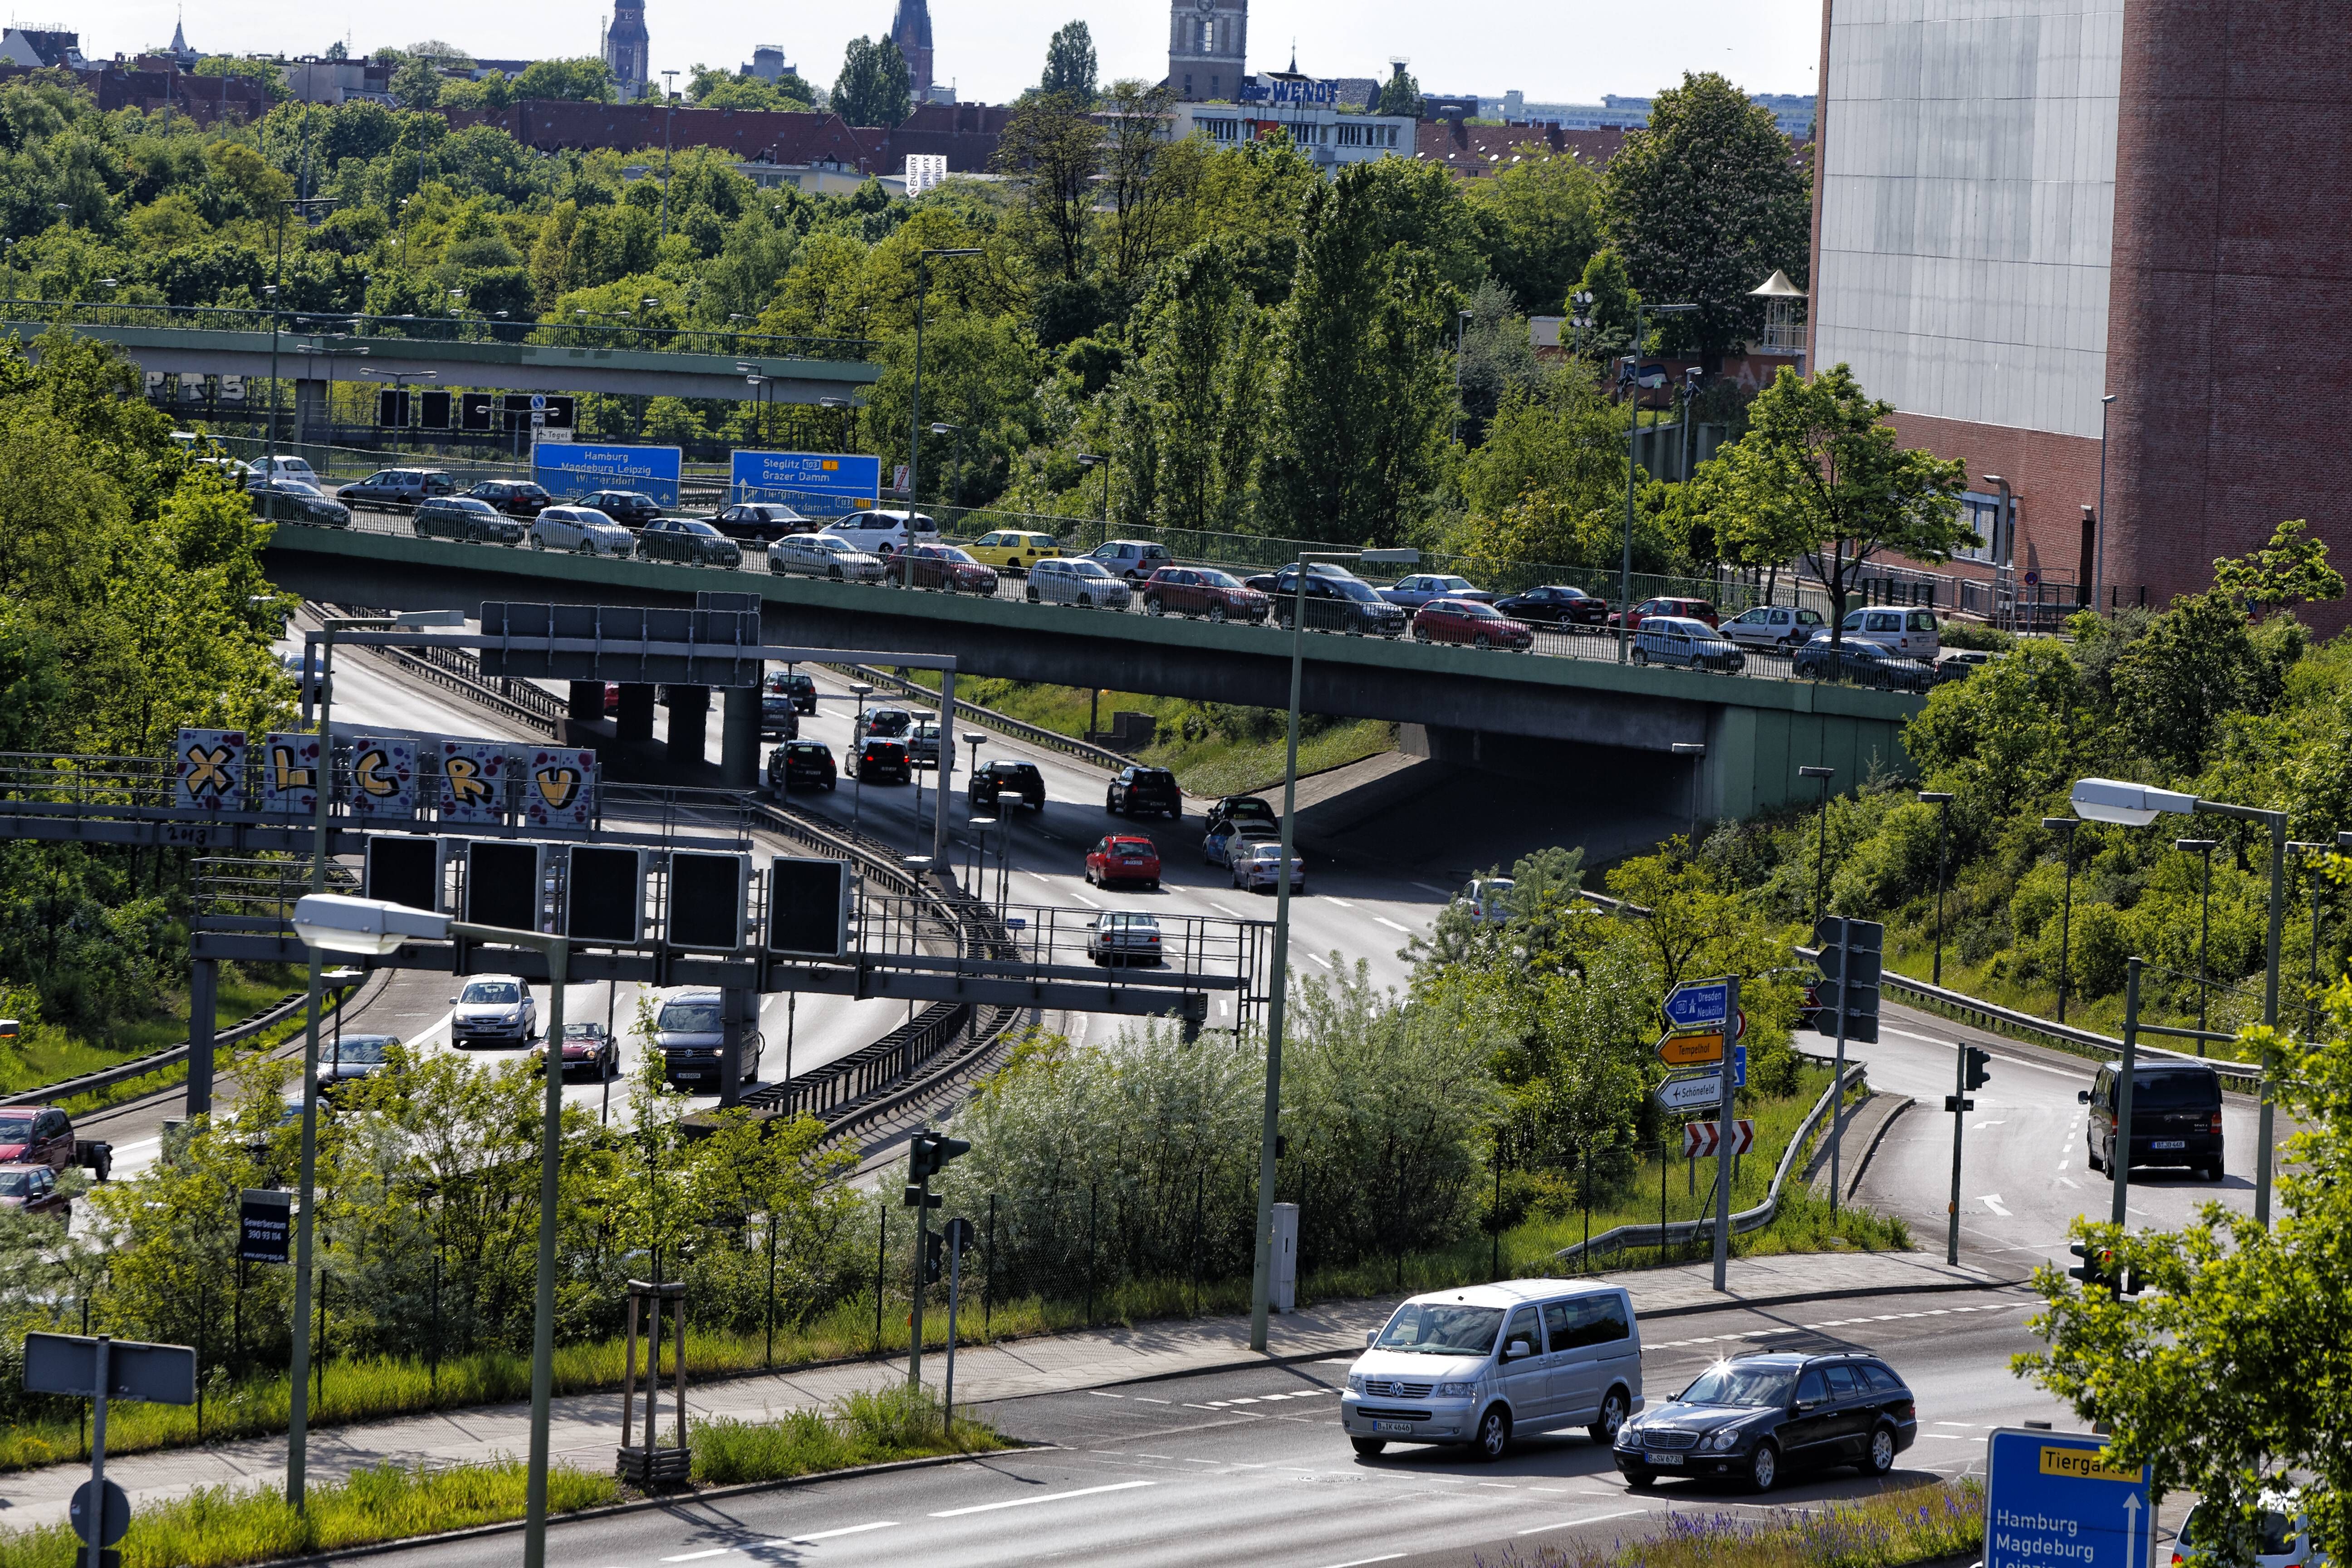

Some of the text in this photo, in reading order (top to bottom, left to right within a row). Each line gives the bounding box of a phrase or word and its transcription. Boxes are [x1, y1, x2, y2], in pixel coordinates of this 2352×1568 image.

[584, 451, 629, 463] Hamburg
[763, 458, 799, 469] Steglitz
[561, 462, 651, 476] Magdeburg Leipzig
[576, 473, 635, 486] Wiersdorf
[763, 470, 830, 482] Grazer Damm
[167, 826, 207, 845] 2013
[1698, 990, 1722, 1002] Dresden
[1677, 1003, 1686, 1011] 100
[1697, 1005, 1722, 1018] Neukölln
[1679, 1043, 1710, 1057] Tempelhof
[1681, 1083, 1715, 1098] Schönefeld
[244, 1217, 286, 1230] Gewerberaum
[248, 1230, 281, 1241] 390 93 114
[1666, 1455, 1682, 1464] 6730
[2045, 1451, 2137, 1475] Tierga
[1997, 1509, 2078, 1537] Hamburg
[1996, 1533, 2093, 1563] Magdeburg
